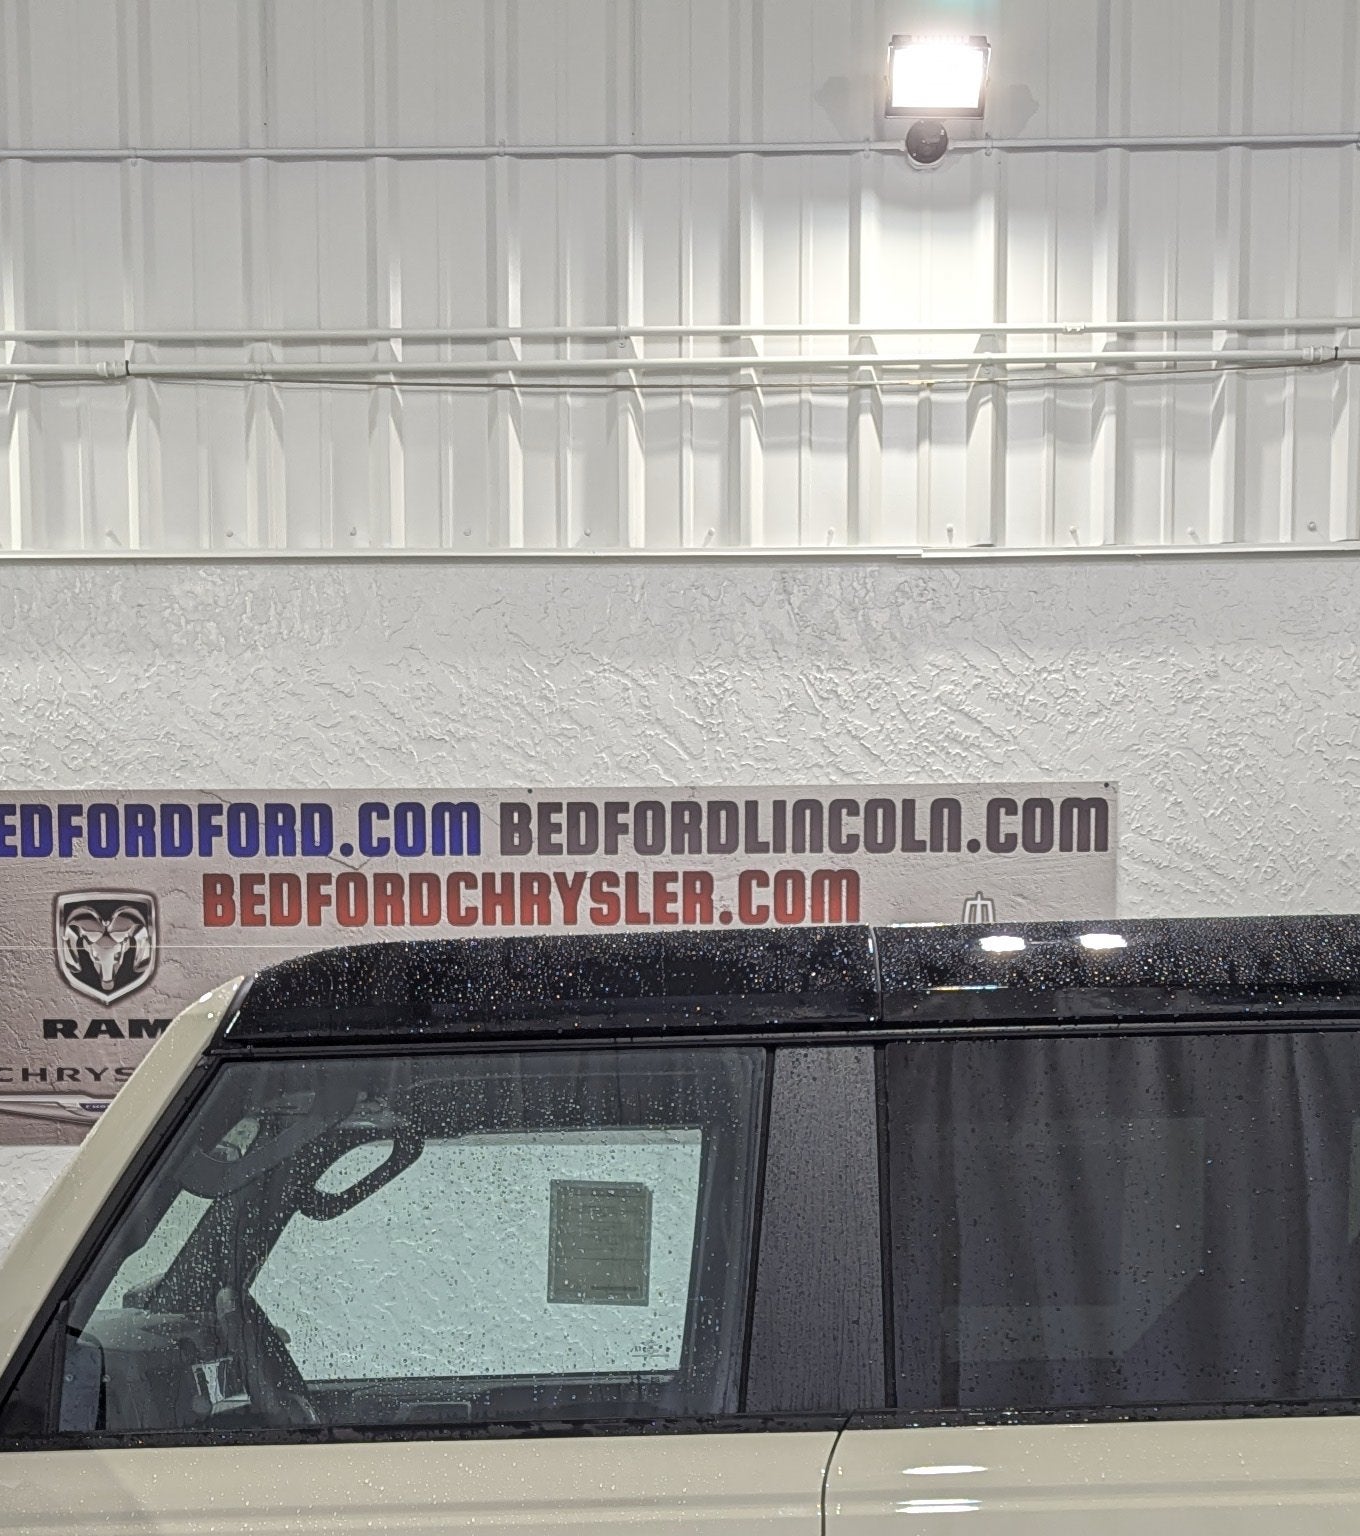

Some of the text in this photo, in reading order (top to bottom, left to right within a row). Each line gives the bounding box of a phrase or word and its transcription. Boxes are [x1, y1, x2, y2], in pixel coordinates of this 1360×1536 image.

[499, 797, 1110, 855] BEDFORDLINCOLN.COM
[202, 868, 861, 927] BEDFORDCHRYSLER.COM
[42, 1018, 174, 1040] RAM
